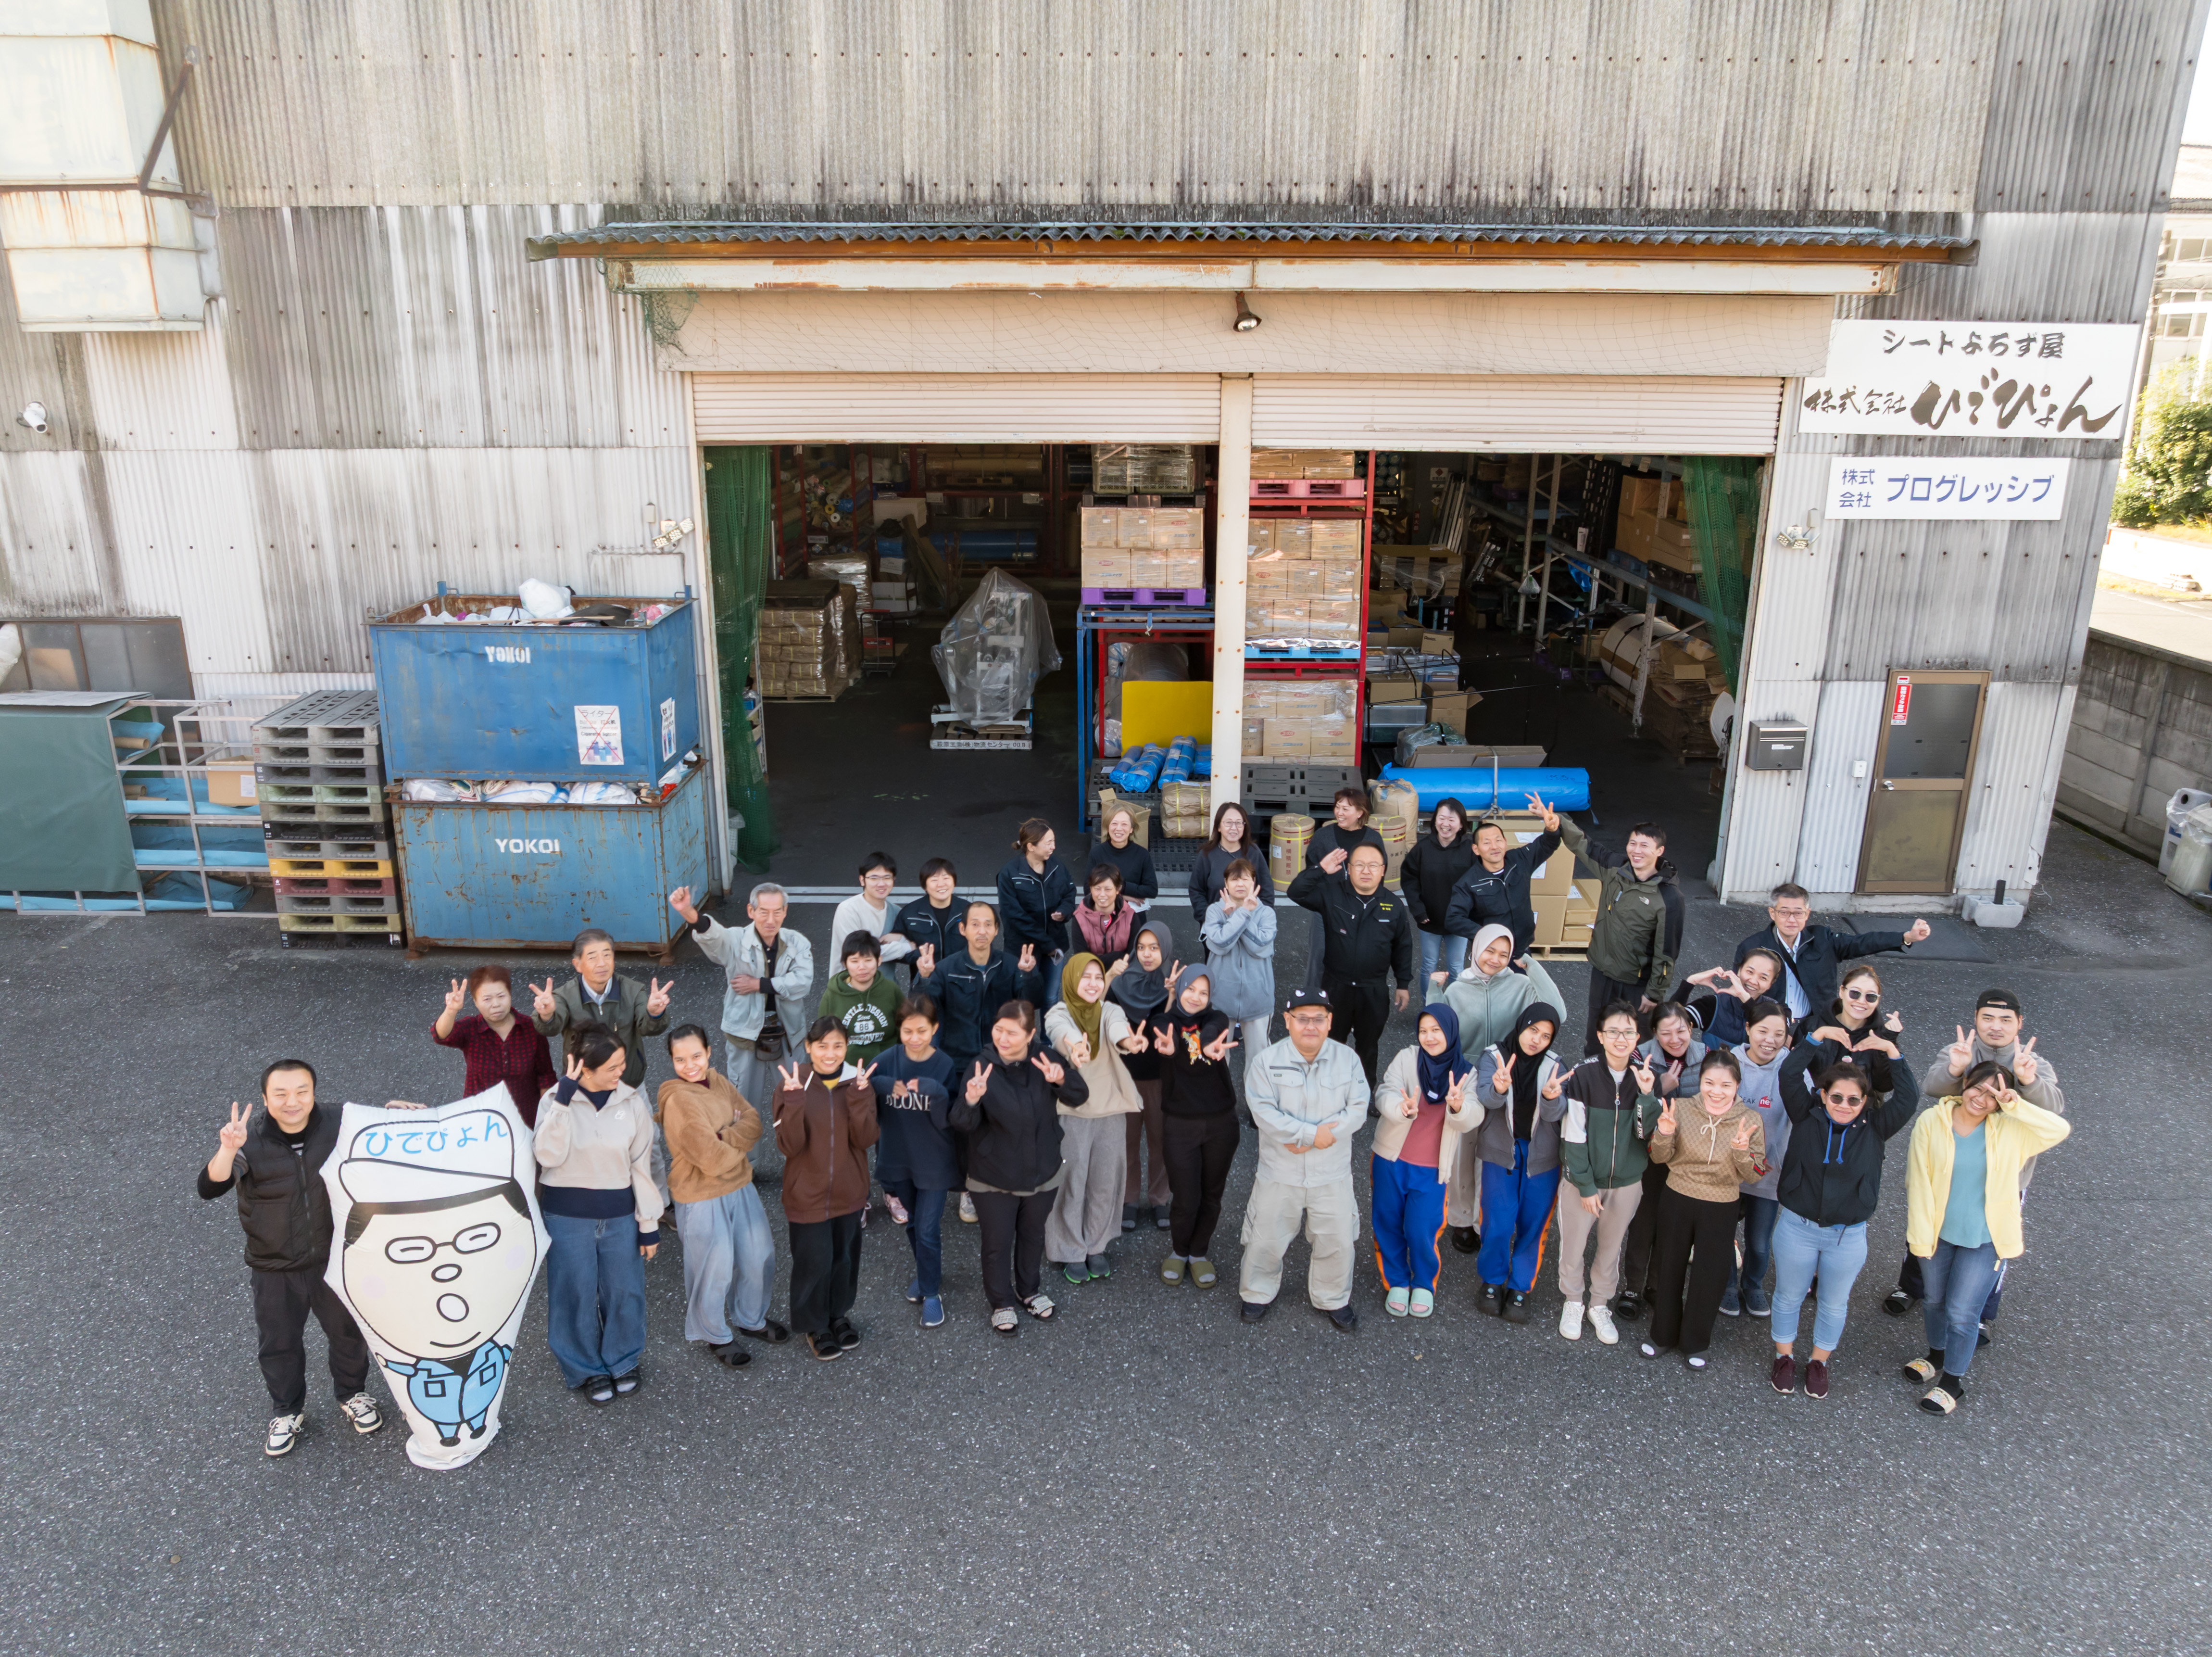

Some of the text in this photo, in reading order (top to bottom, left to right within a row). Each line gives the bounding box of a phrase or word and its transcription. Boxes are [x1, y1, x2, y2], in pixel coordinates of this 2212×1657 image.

[1882, 329, 2065, 358] シートよろず屋
[1841, 468, 2055, 503] 株式 プログレッシブ
[1839, 492, 1872, 508] 会社
[485, 646, 531, 663] YOKOI
[494, 838, 560, 854] YOKOI
[842, 1003, 864, 1029] ENTLE
[365, 1115, 508, 1157] ひでぴょん
